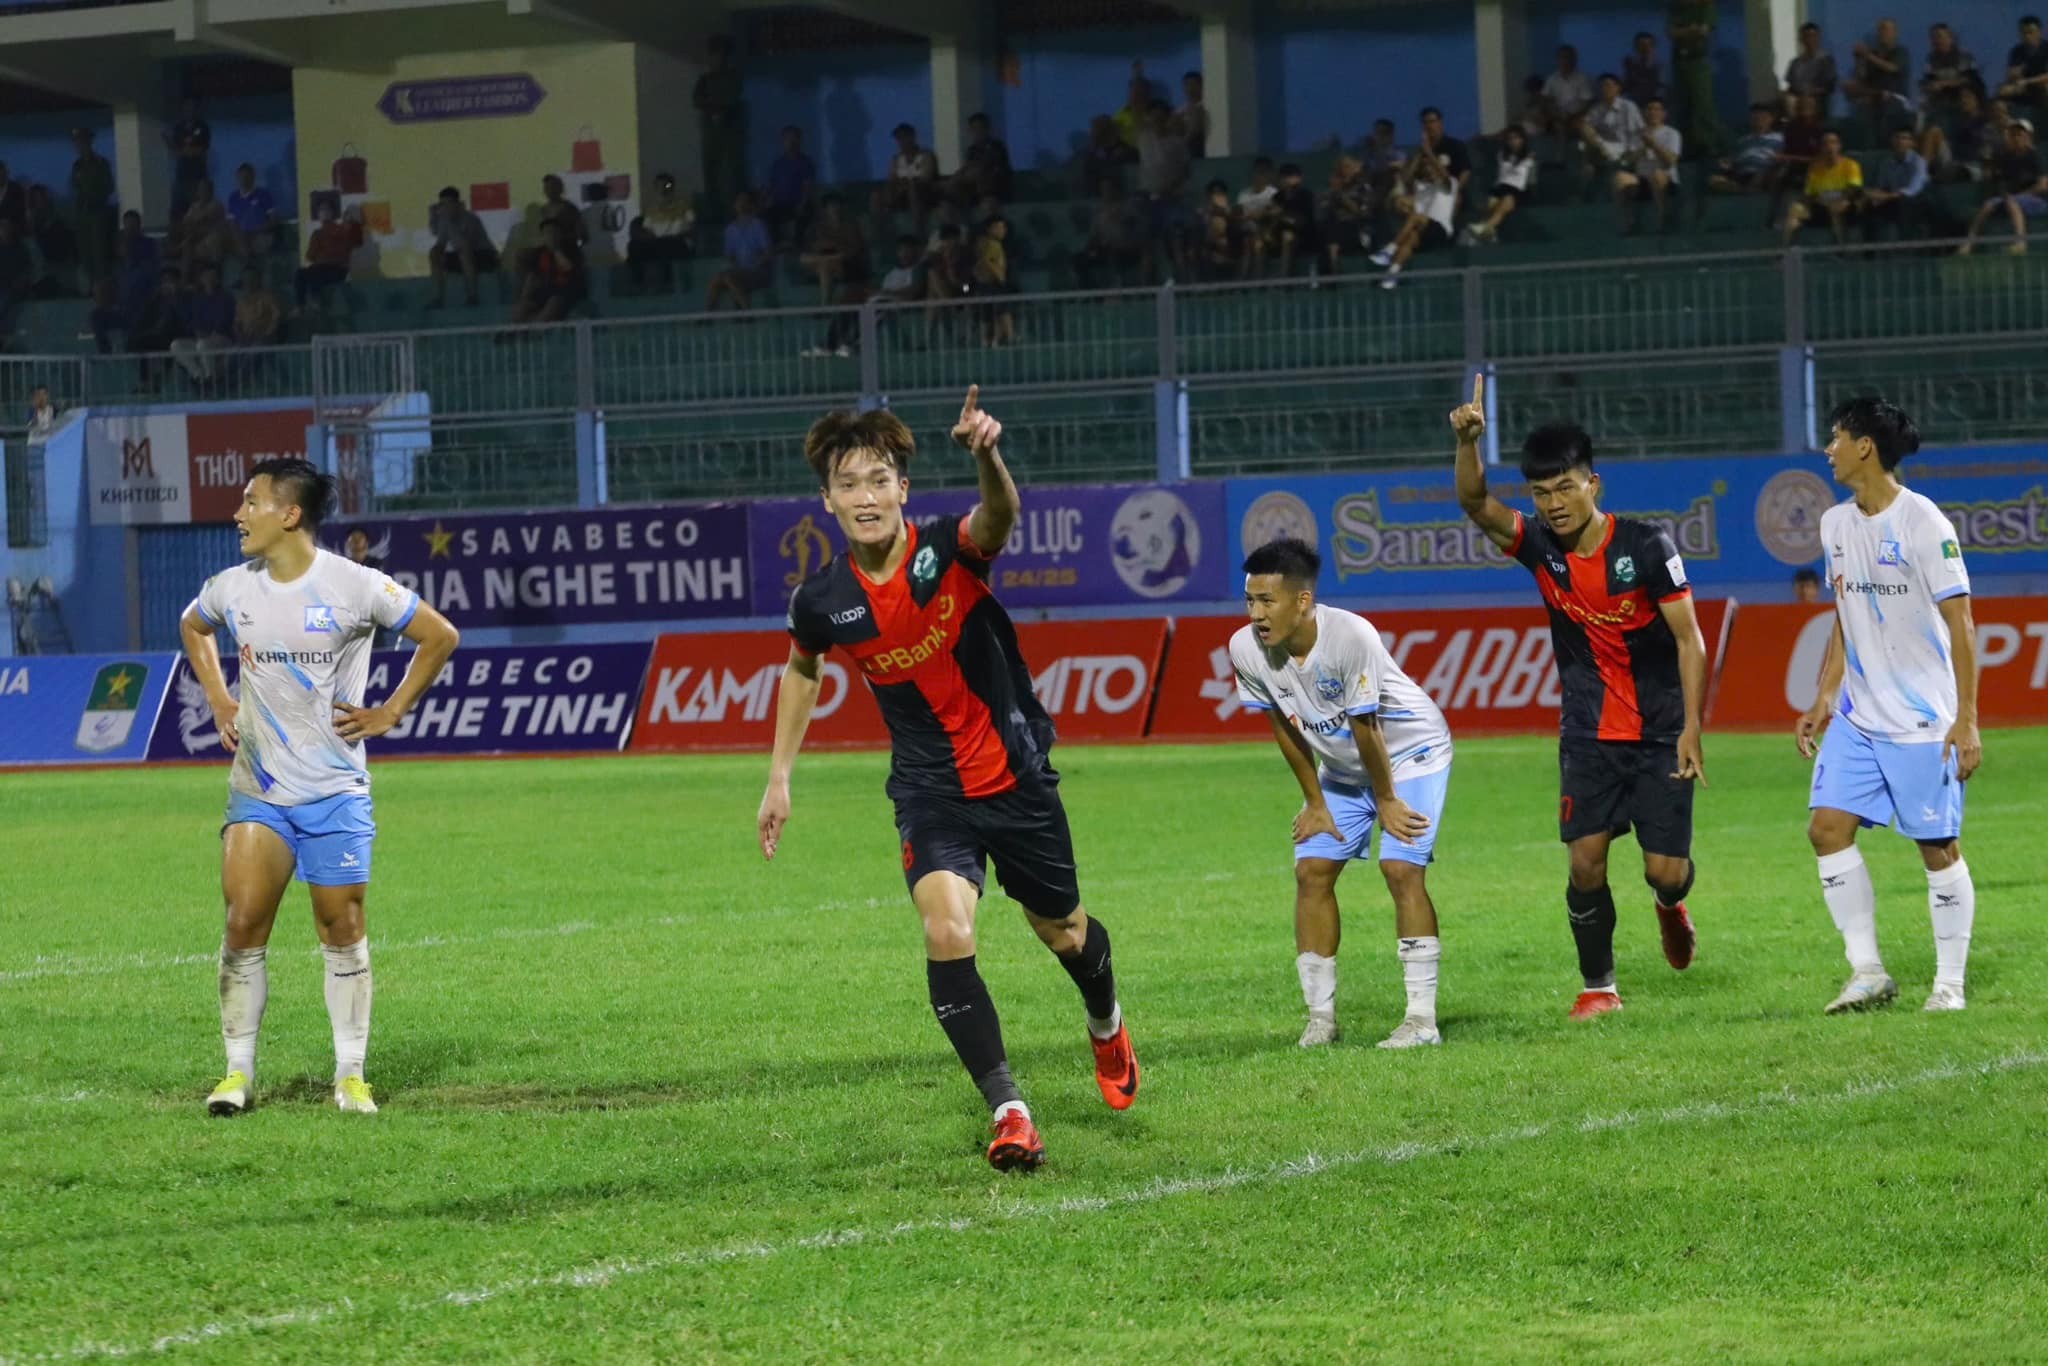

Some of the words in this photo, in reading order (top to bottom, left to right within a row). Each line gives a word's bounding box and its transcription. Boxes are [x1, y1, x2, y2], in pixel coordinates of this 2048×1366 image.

[461, 518, 699, 557] SAVABECO
[484, 561, 617, 609] NGHE
[626, 556, 744, 603] TINH
[829, 605, 867, 625] VLOOP
[255, 651, 334, 664] KHATOCO
[500, 692, 627, 736] TINH
[648, 663, 849, 724] KAMIO
